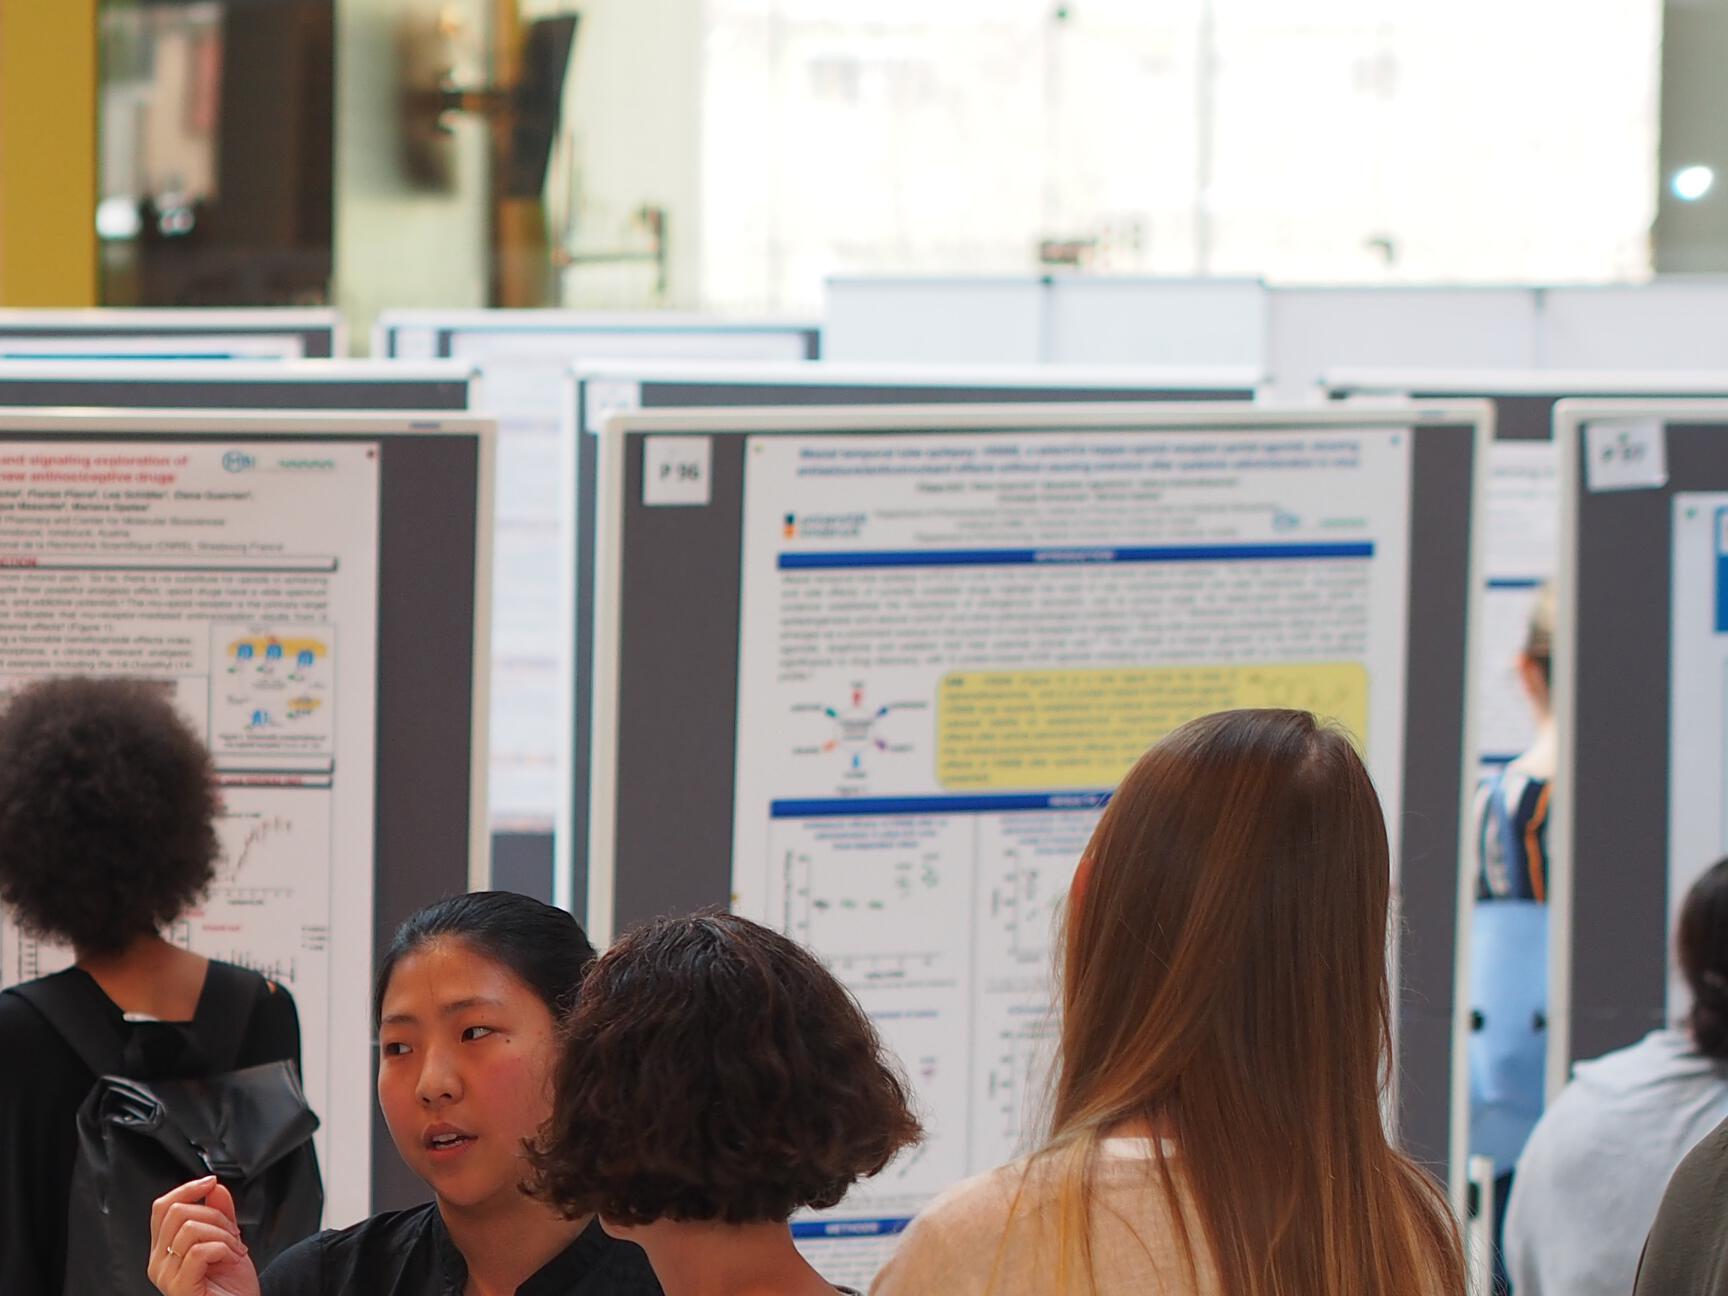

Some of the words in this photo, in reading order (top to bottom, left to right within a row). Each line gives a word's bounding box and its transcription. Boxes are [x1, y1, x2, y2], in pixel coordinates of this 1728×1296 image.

[0, 456, 25, 466] and
[29, 455, 91, 468] signaling
[94, 455, 170, 468] exploration
[174, 456, 188, 466] of
[30, 472, 132, 484] antinociceptive
[135, 473, 175, 484] drugs
[660, 463, 671, 479] P
[679, 463, 700, 480] 96
